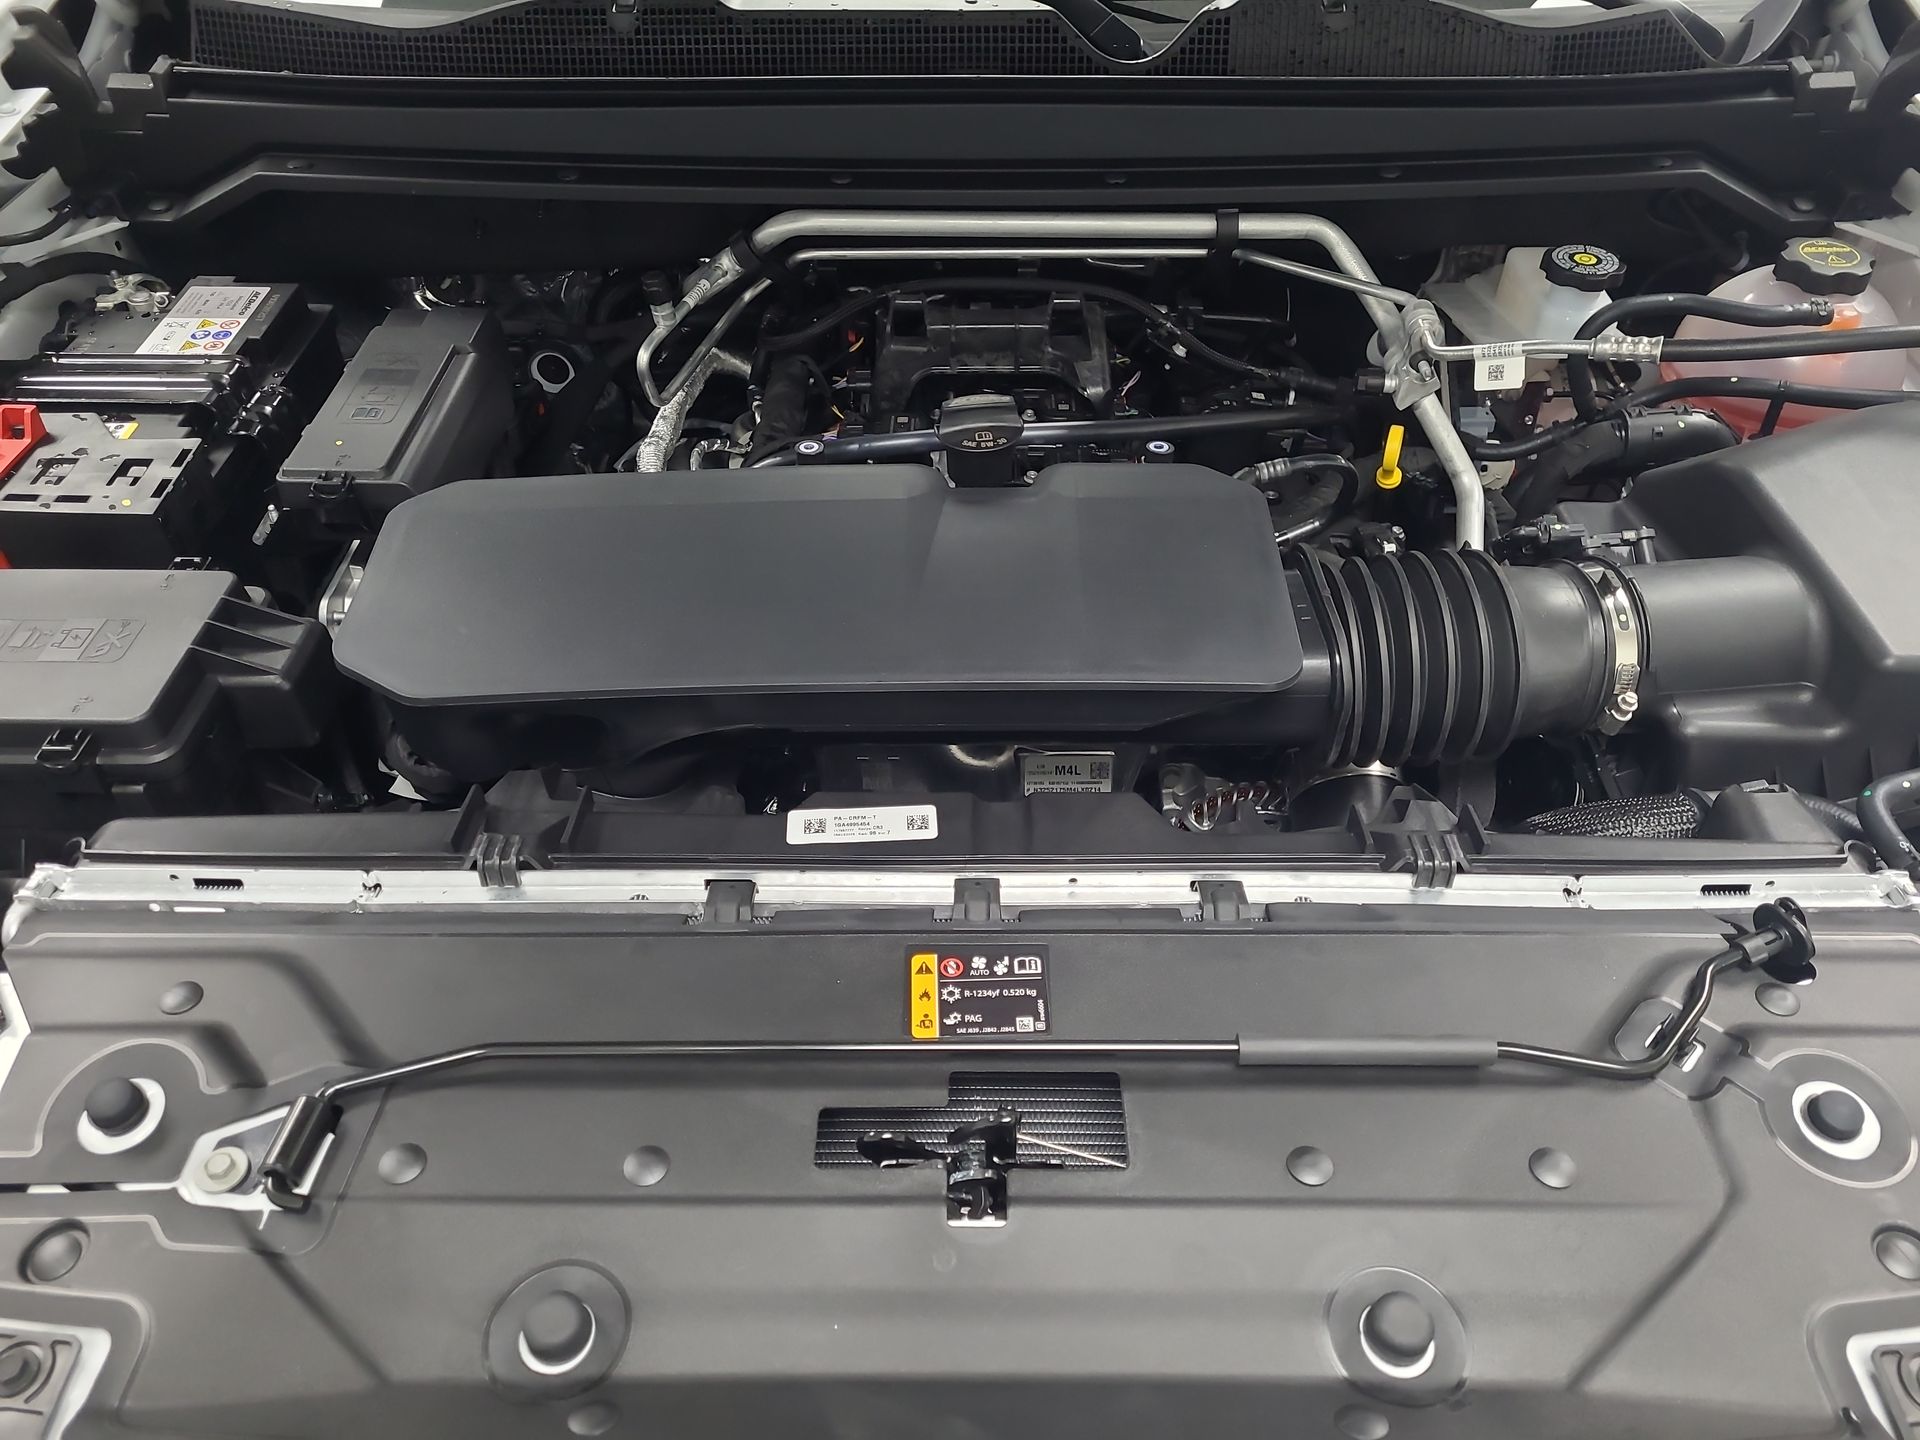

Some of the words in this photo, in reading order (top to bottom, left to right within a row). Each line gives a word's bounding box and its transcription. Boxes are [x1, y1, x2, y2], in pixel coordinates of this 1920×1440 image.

[238, 290, 262, 316] ACDelco
[961, 440, 978, 448] SAE
[1054, 764, 1082, 776] M4L
[964, 988, 1000, 999] R-1234yf
[1002, 989, 1025, 997] 0.520
[1026, 988, 1037, 997] kg
[964, 1014, 983, 1023] PAG
